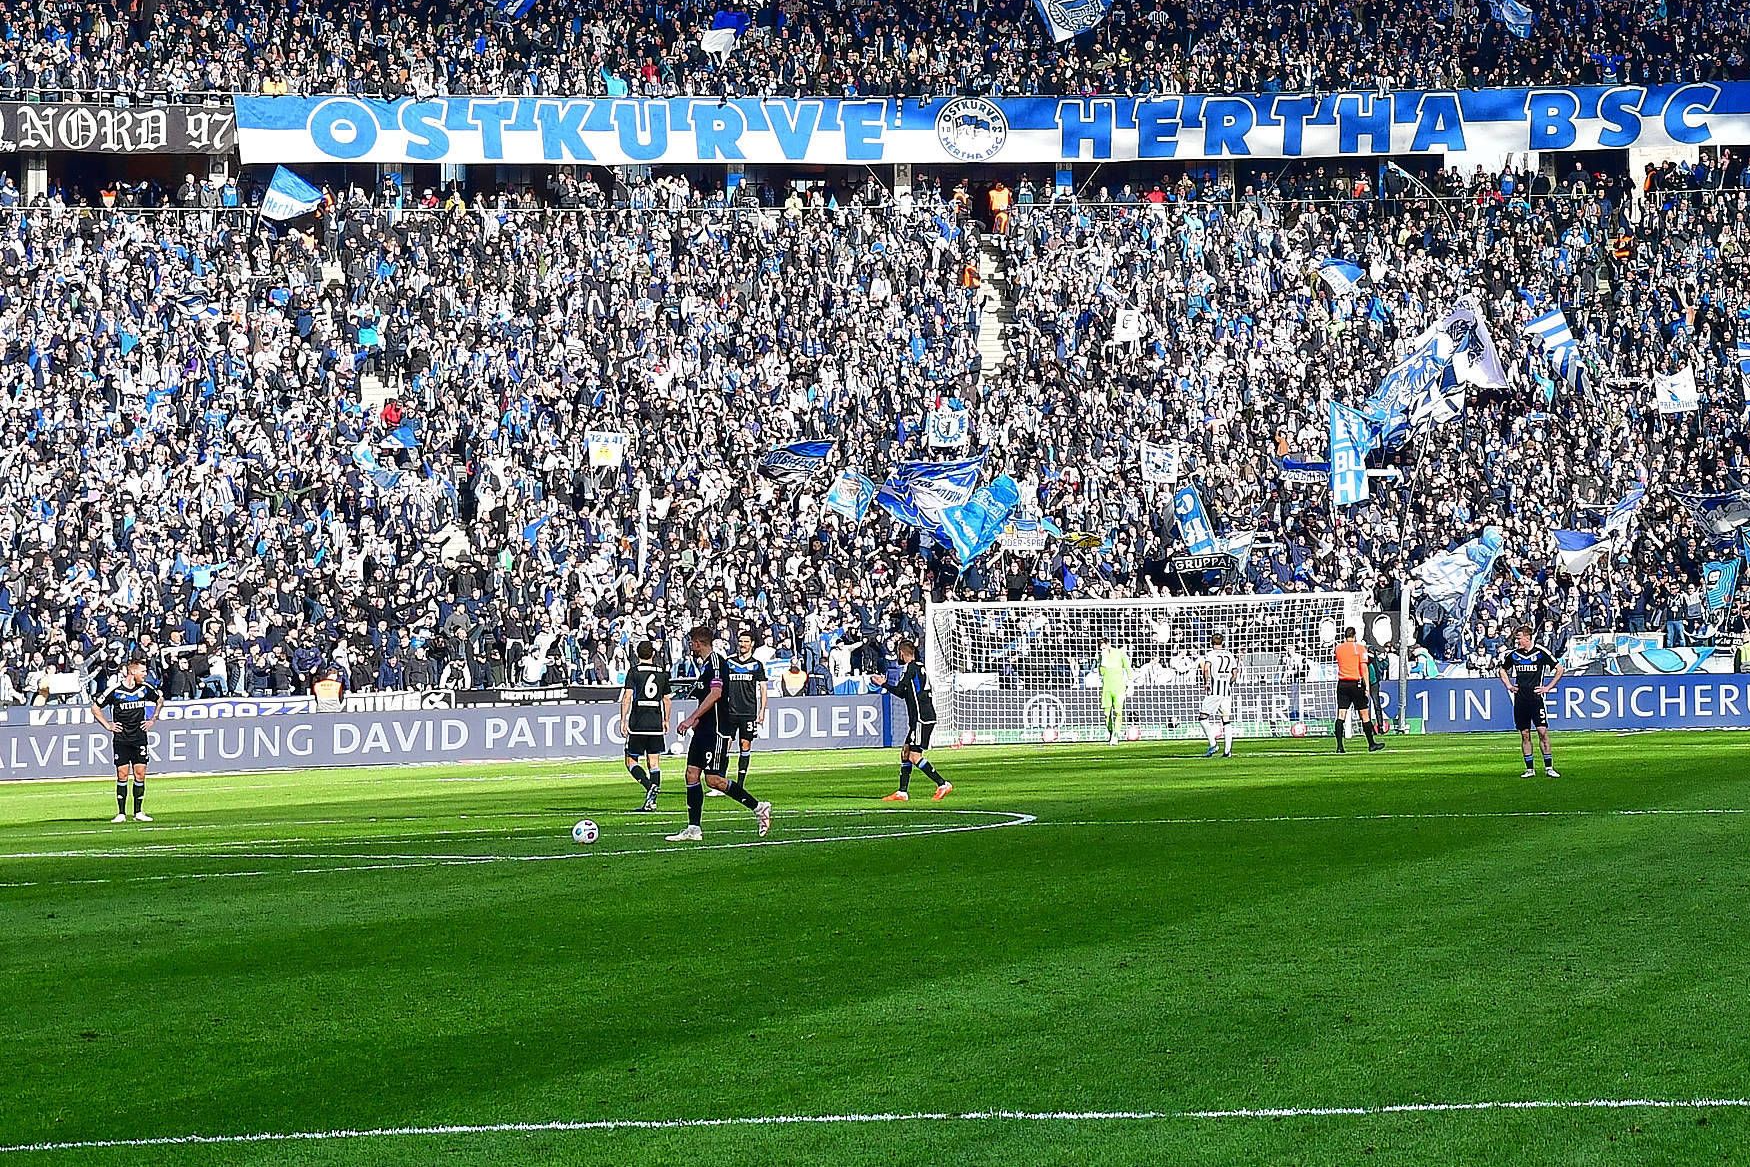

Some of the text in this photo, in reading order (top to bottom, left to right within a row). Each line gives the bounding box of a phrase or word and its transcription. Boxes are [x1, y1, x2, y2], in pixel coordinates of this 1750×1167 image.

[307, 83, 1722, 163] OSTKURVE HERTHA BSC
[943, 100, 1001, 123] OSTKURVE
[17, 105, 235, 152] NORD '97
[1217, 655, 1231, 674] 22
[644, 674, 658, 699] 6
[1449, 689, 1492, 720] IN
[1539, 708, 1546, 719] 5
[0, 722, 314, 769] LVERRETUNG
[333, 719, 470, 755] DAVID
[485, 709, 629, 748] PATRIC
[705, 751, 713, 764] 9
